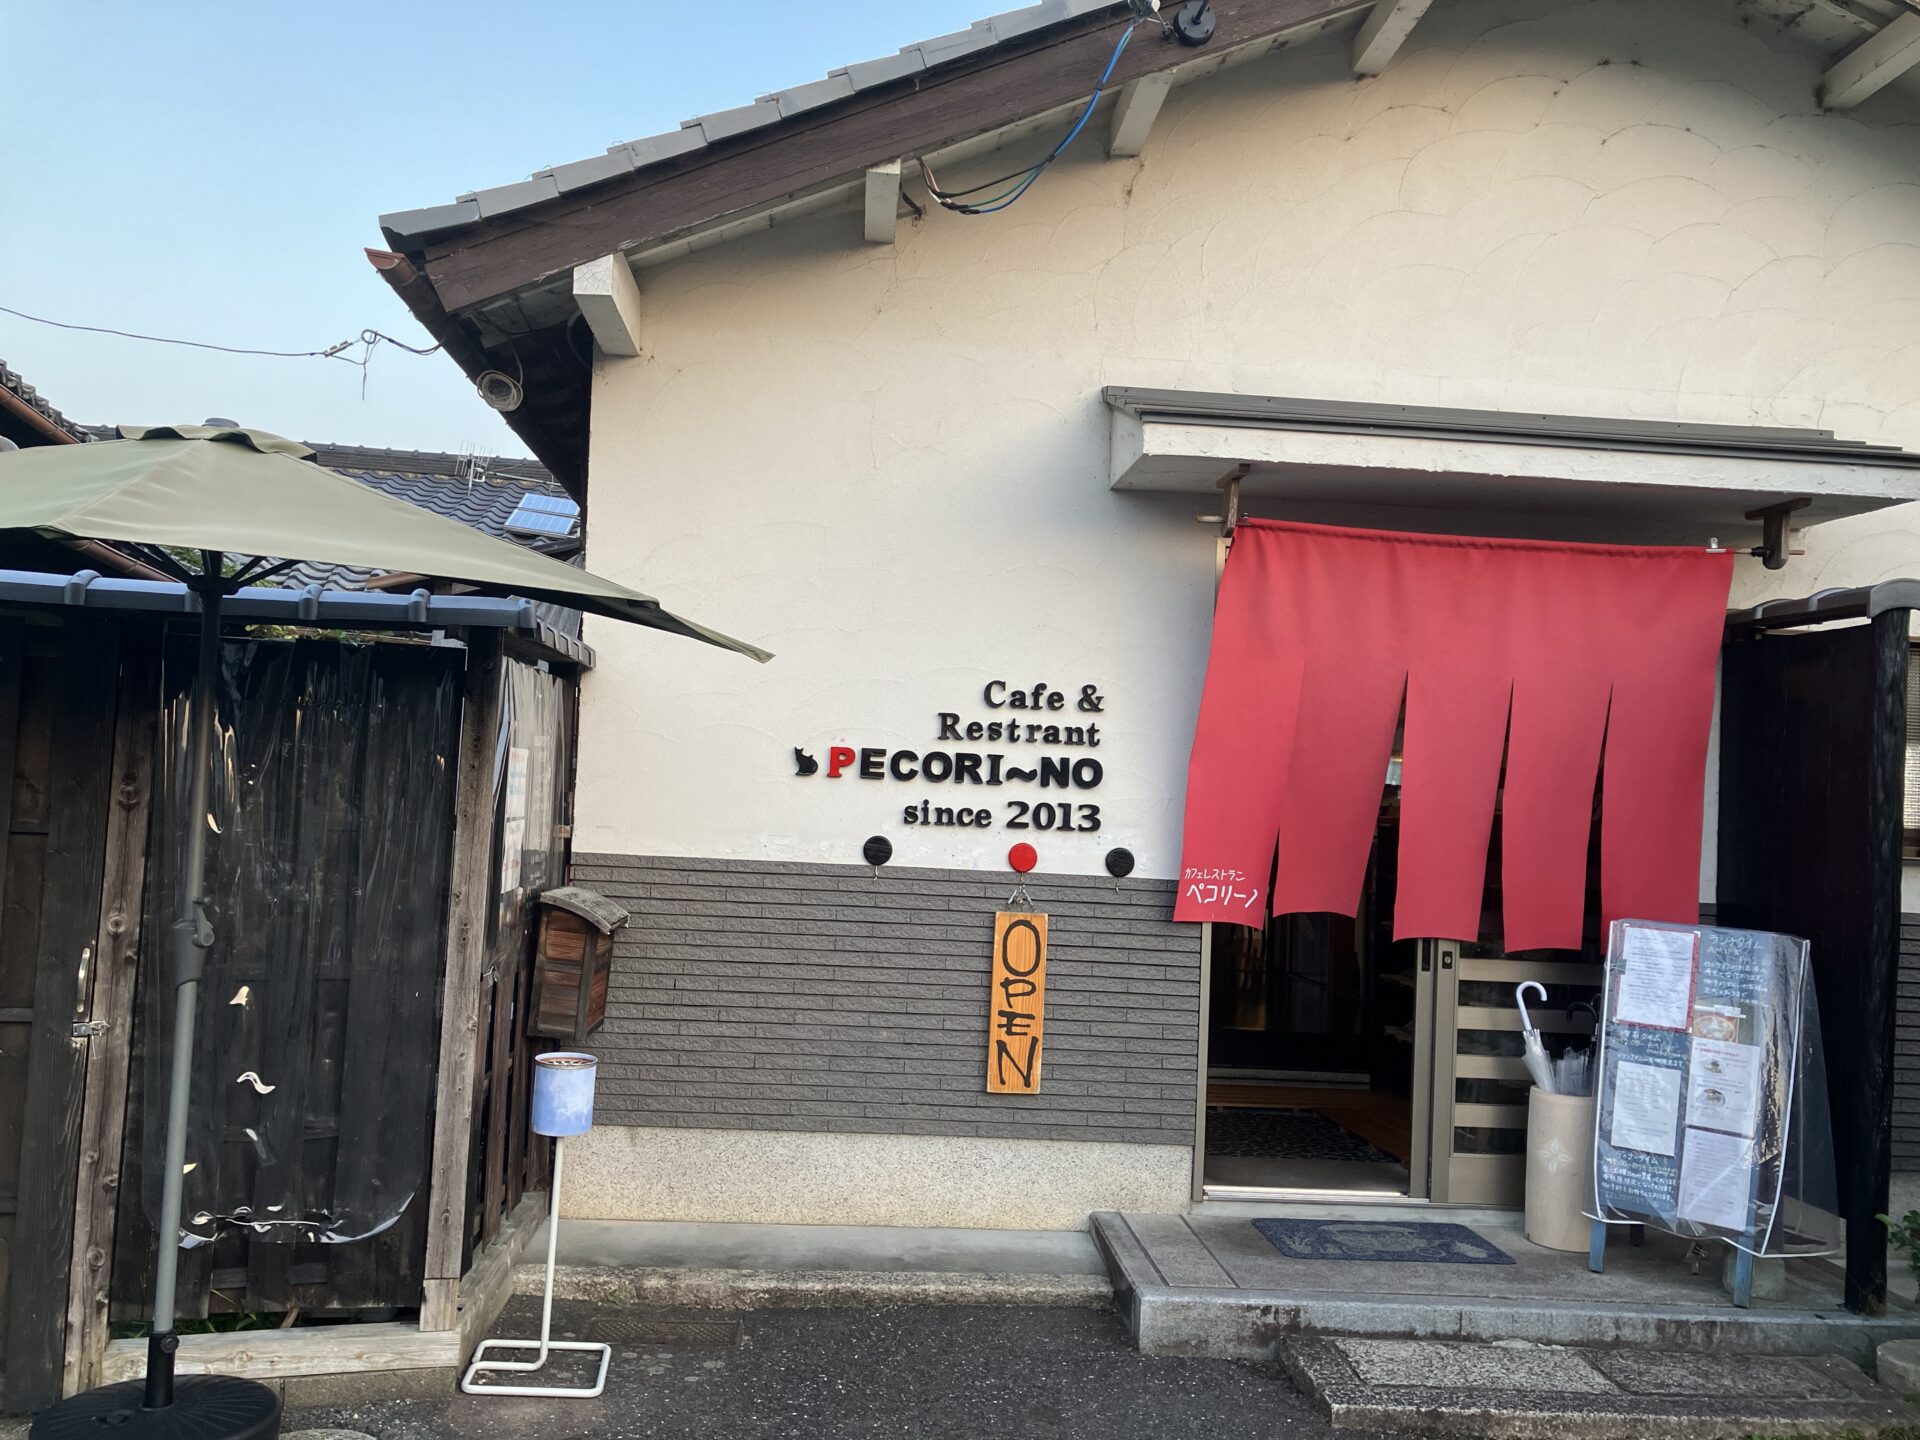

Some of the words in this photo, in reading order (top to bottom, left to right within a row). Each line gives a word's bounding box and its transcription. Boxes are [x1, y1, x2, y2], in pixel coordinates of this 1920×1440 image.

[983, 680, 1065, 711] Cafe
[1077, 684, 1104, 712] &
[937, 712, 1101, 747] Restrant
[903, 799, 992, 827] since
[1006, 800, 1102, 832] 2013
[1184, 867, 1246, 882] カフェレストラン
[1186, 883, 1259, 908] ペコリーノ
[996, 919, 1041, 1088] OPEN
